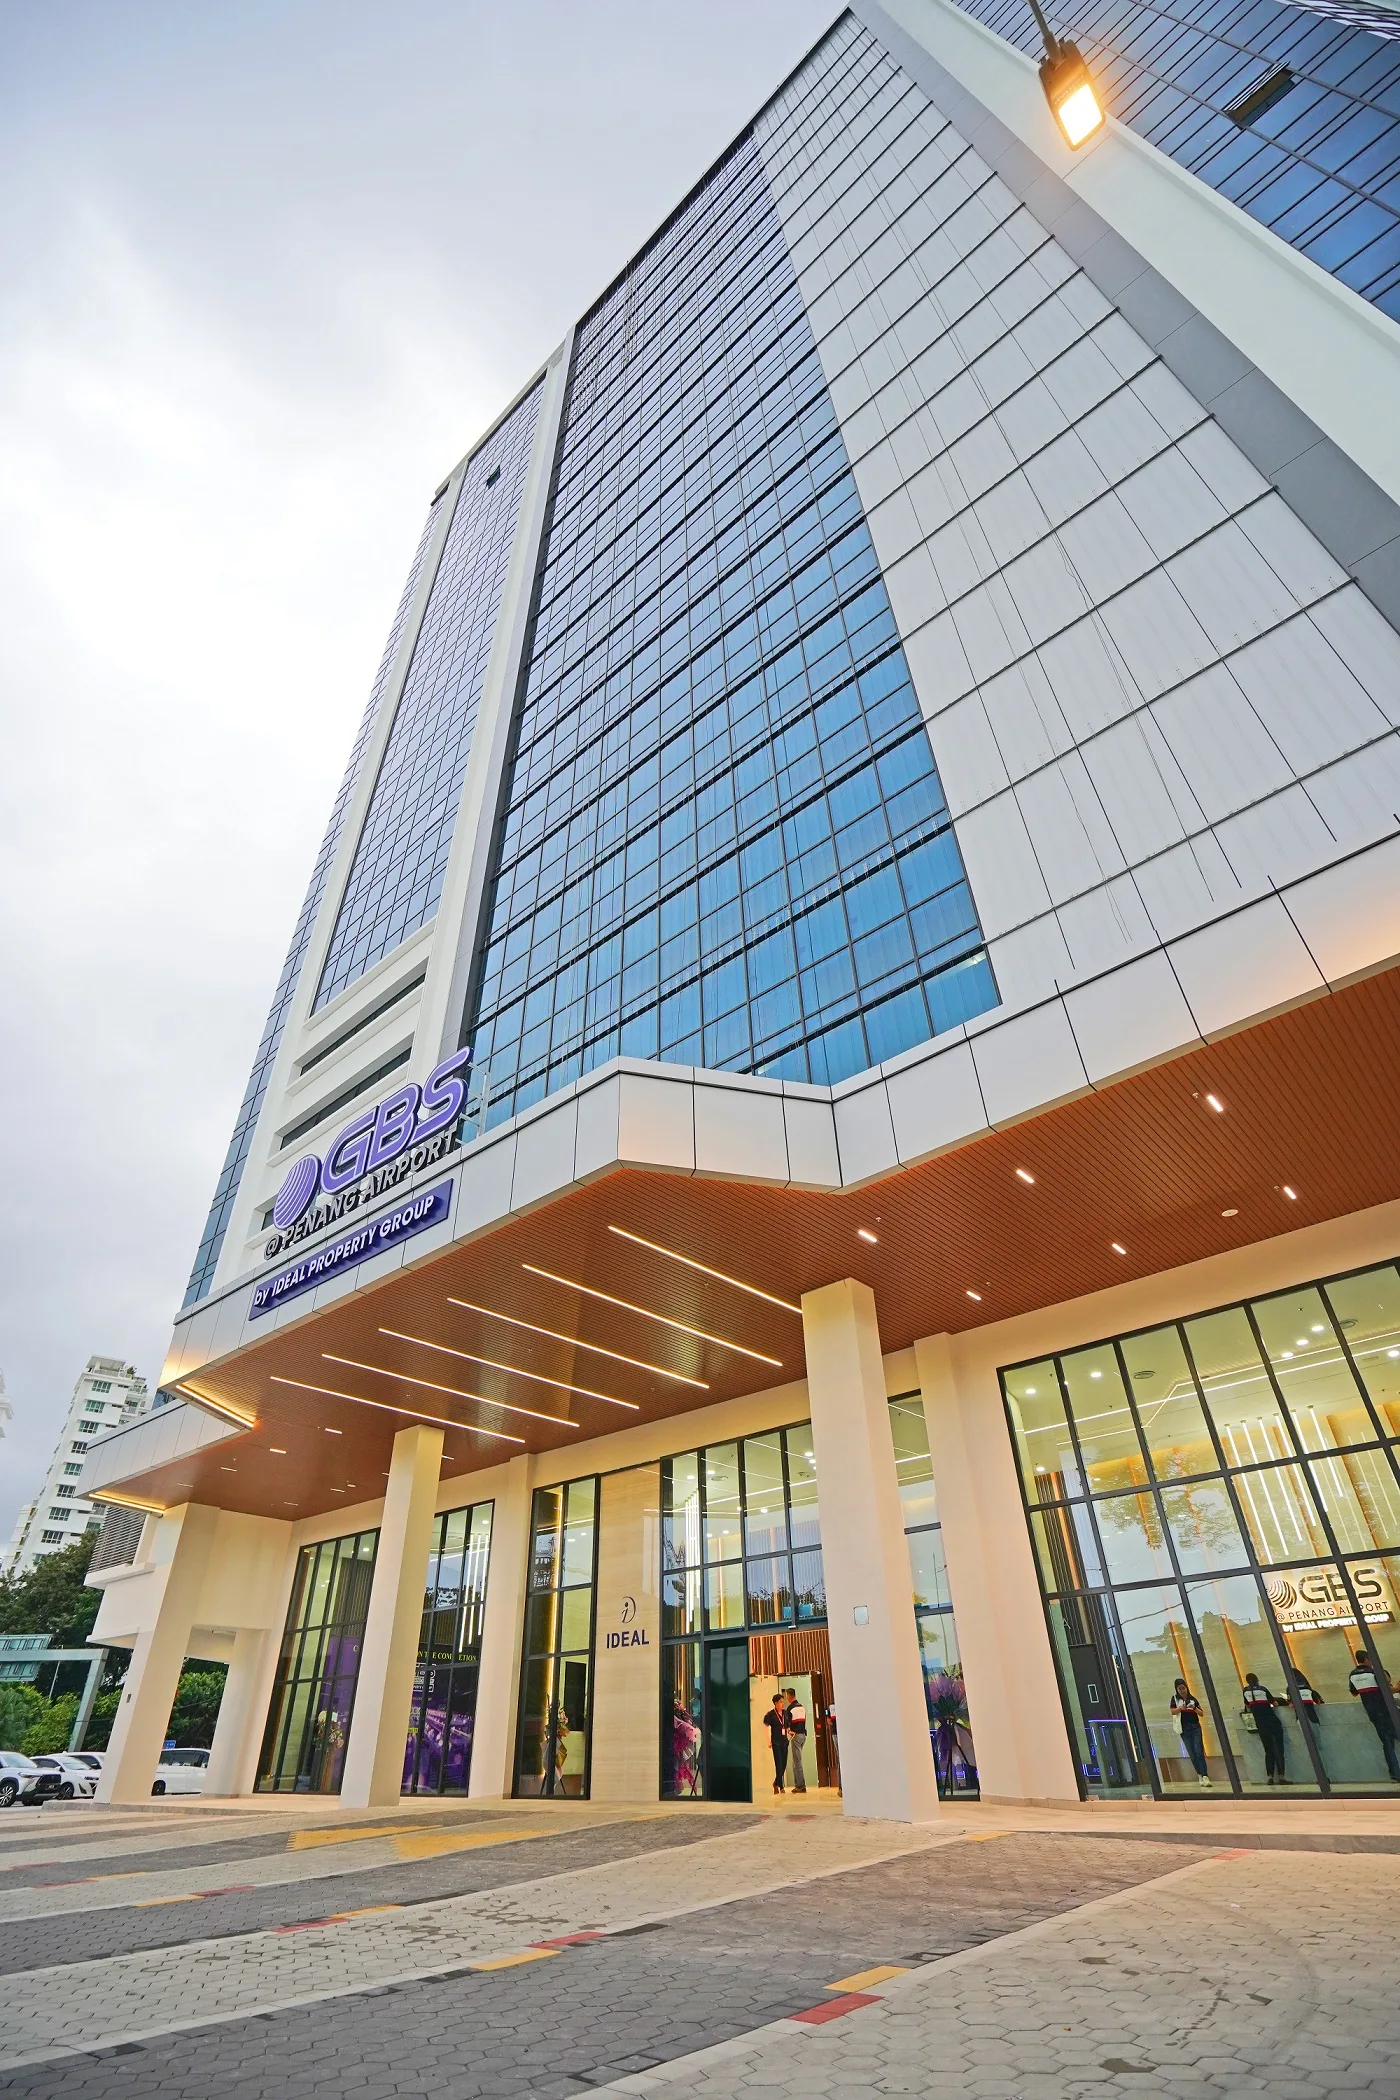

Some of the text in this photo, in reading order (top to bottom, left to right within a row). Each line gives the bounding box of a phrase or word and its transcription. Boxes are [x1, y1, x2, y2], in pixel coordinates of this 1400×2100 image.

[320, 1046, 473, 1195] GBS
[281, 1186, 359, 1250] PENANG
[360, 1129, 457, 1203] AIRPORT
[254, 1195, 435, 1306] by IDEAL PROPERTY GROUP
[607, 1629, 649, 1649] IDEAL
[1288, 1607, 1335, 1621] PENANG
[438, 1652, 477, 1661] COMETION
